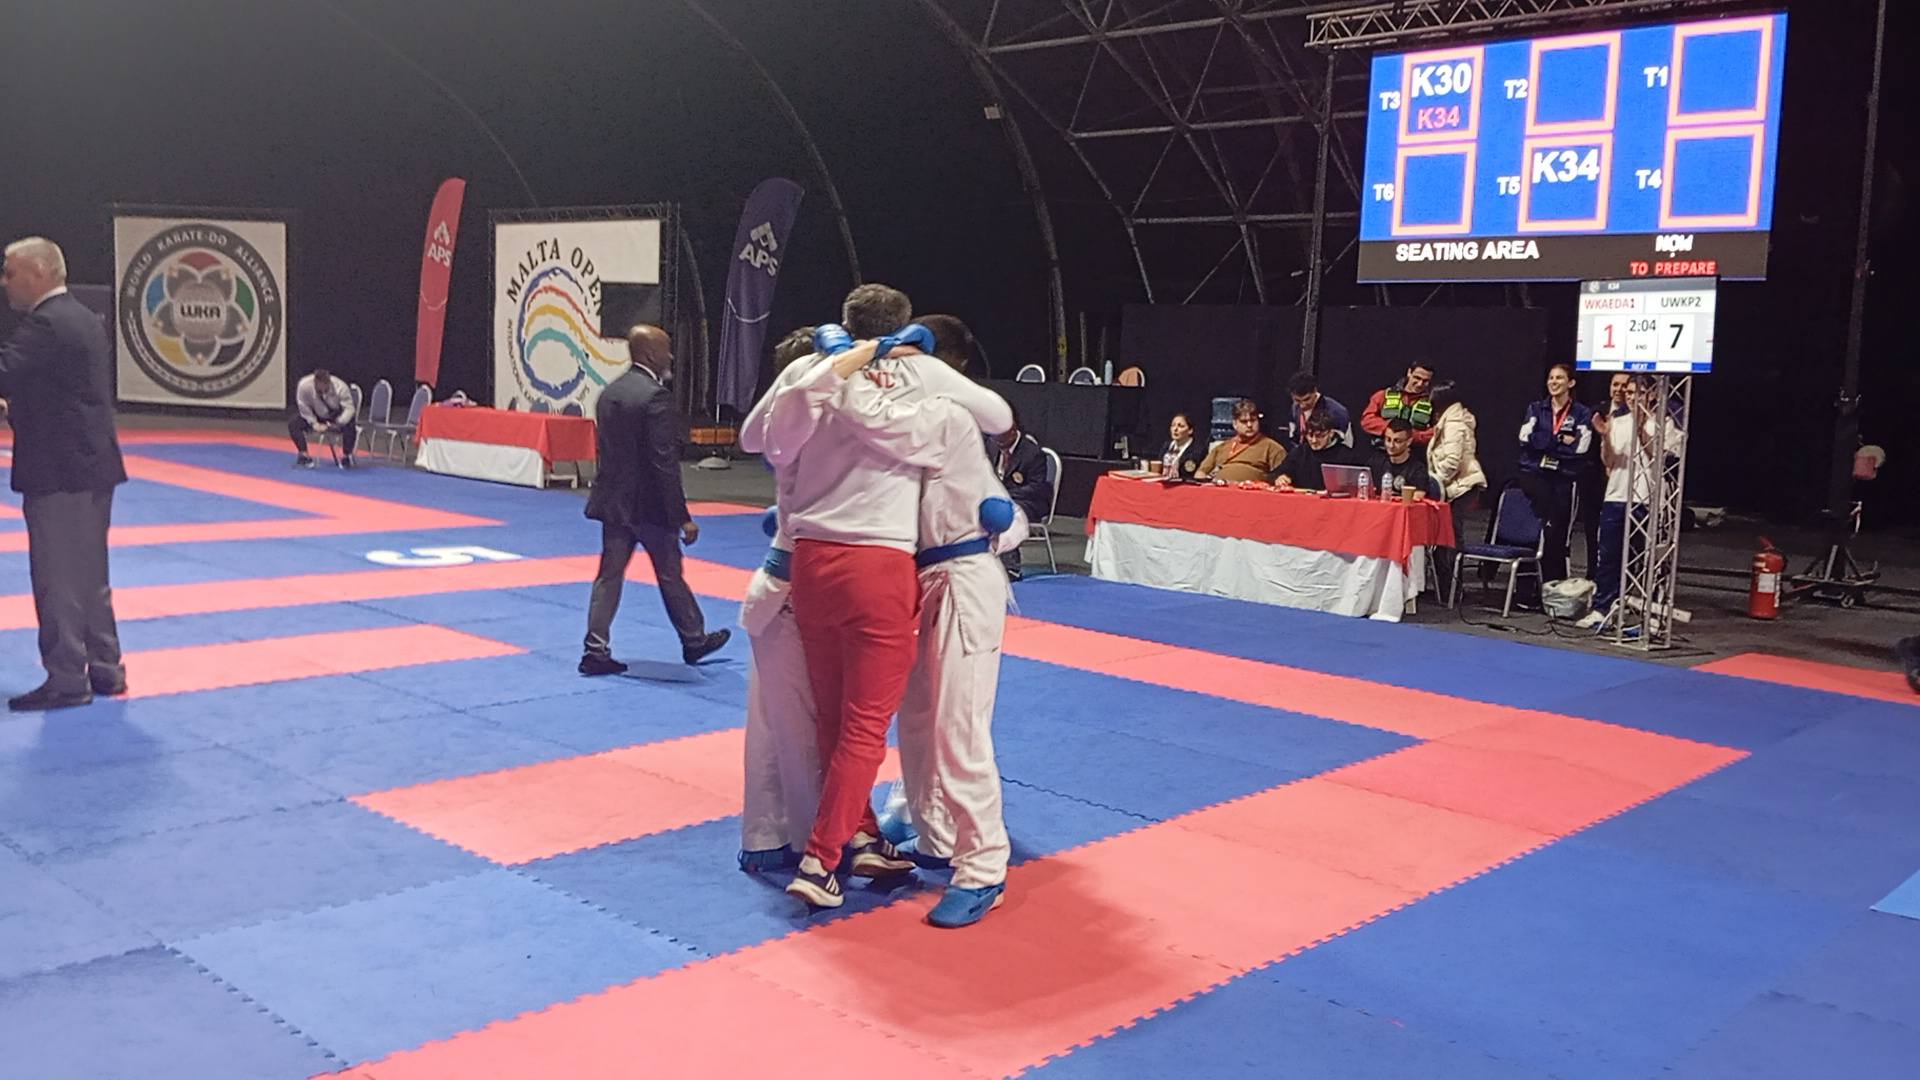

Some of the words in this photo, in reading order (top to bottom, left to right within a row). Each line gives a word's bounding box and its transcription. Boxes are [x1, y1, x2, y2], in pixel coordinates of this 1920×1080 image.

[1411, 63, 1472, 97] K30
[1643, 66, 1669, 88] T1
[1379, 91, 1400, 110] T3
[1504, 79, 1528, 100] T2
[1417, 105, 1460, 130] K34
[1532, 148, 1599, 184] K34
[1497, 176, 1520, 196] T5
[1635, 169, 1662, 190] T4
[1373, 183, 1394, 201] T6
[427, 242, 452, 267] APS
[739, 243, 779, 277] APS
[1396, 241, 1479, 262] SEATING
[1482, 240, 1540, 260] AREA
[127, 253, 152, 298] WORLD
[236, 246, 275, 304] ALLIANCE
[506, 237, 561, 305] MALTA
[1631, 261, 1649, 276] TO
[1655, 261, 1717, 276] PREPARE
[1661, 296, 1702, 308] UWKP2
[1603, 324, 1616, 348] 1
[1629, 319, 1656, 332] 2:04
[1669, 323, 1684, 349] 7
